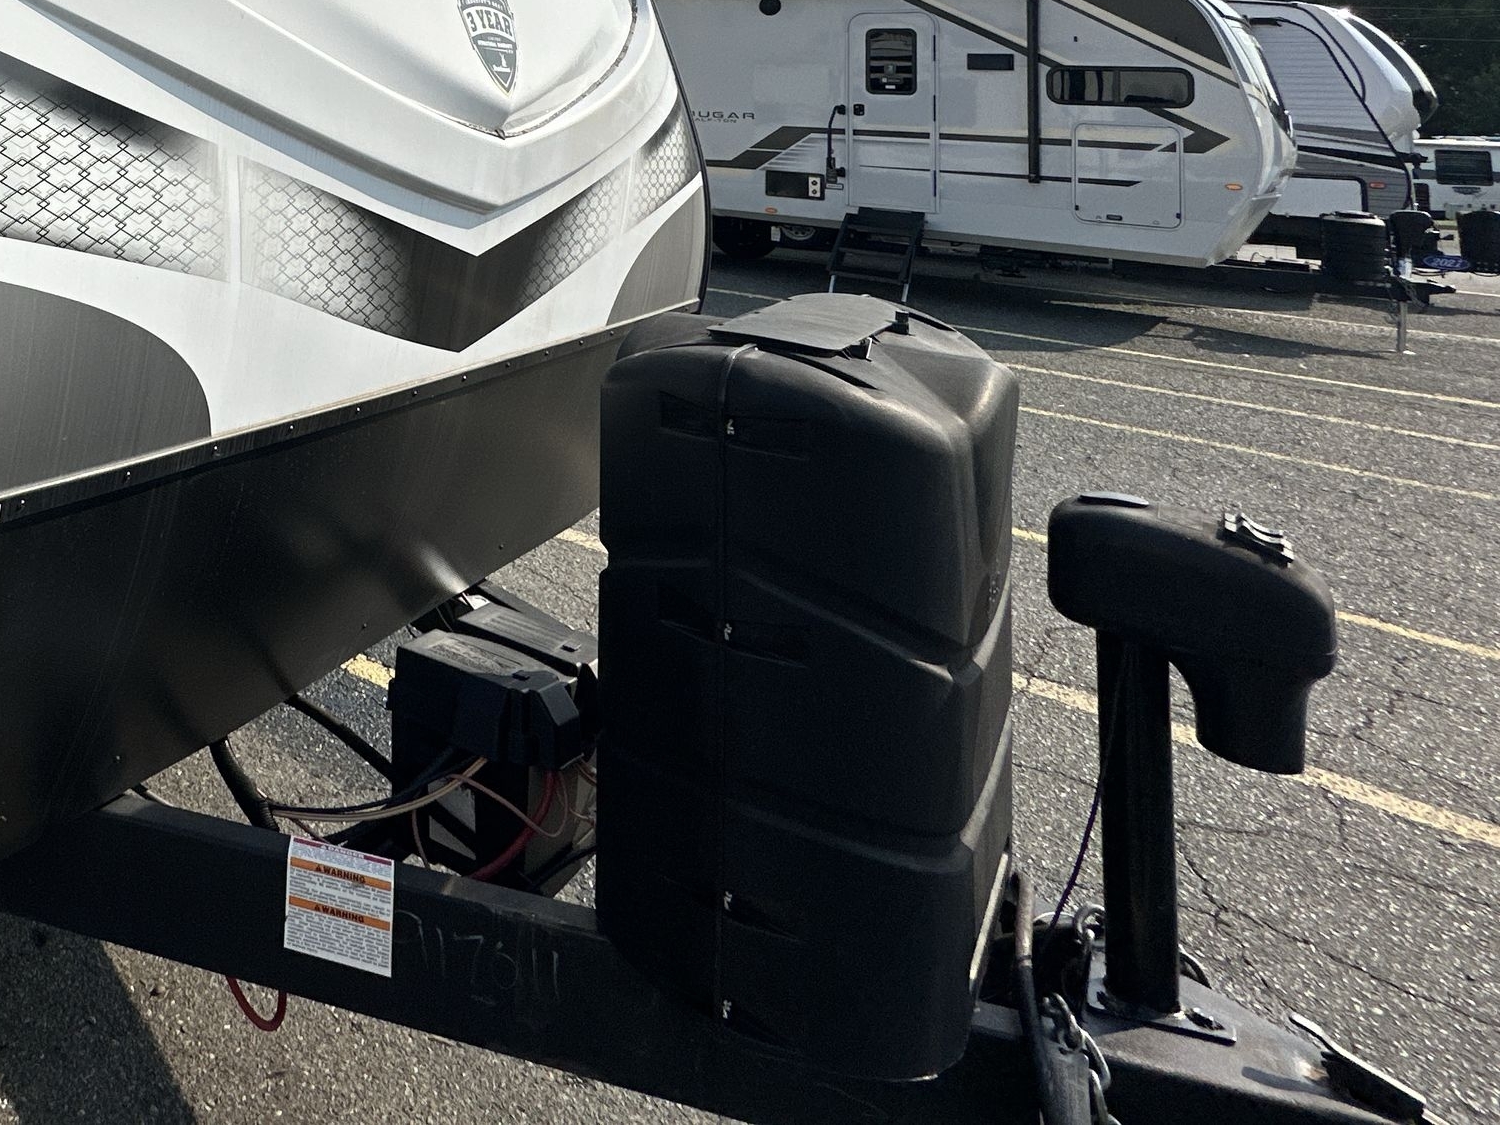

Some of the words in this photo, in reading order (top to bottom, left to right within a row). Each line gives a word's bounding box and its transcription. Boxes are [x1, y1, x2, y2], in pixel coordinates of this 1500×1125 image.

[466, 11, 477, 33] 3
[476, 9, 513, 37] YEAR
[692, 110, 755, 119] UGAR
[328, 846, 365, 859] DANGER
[321, 865, 366, 885] WARNING
[321, 903, 365, 924] WARNING
